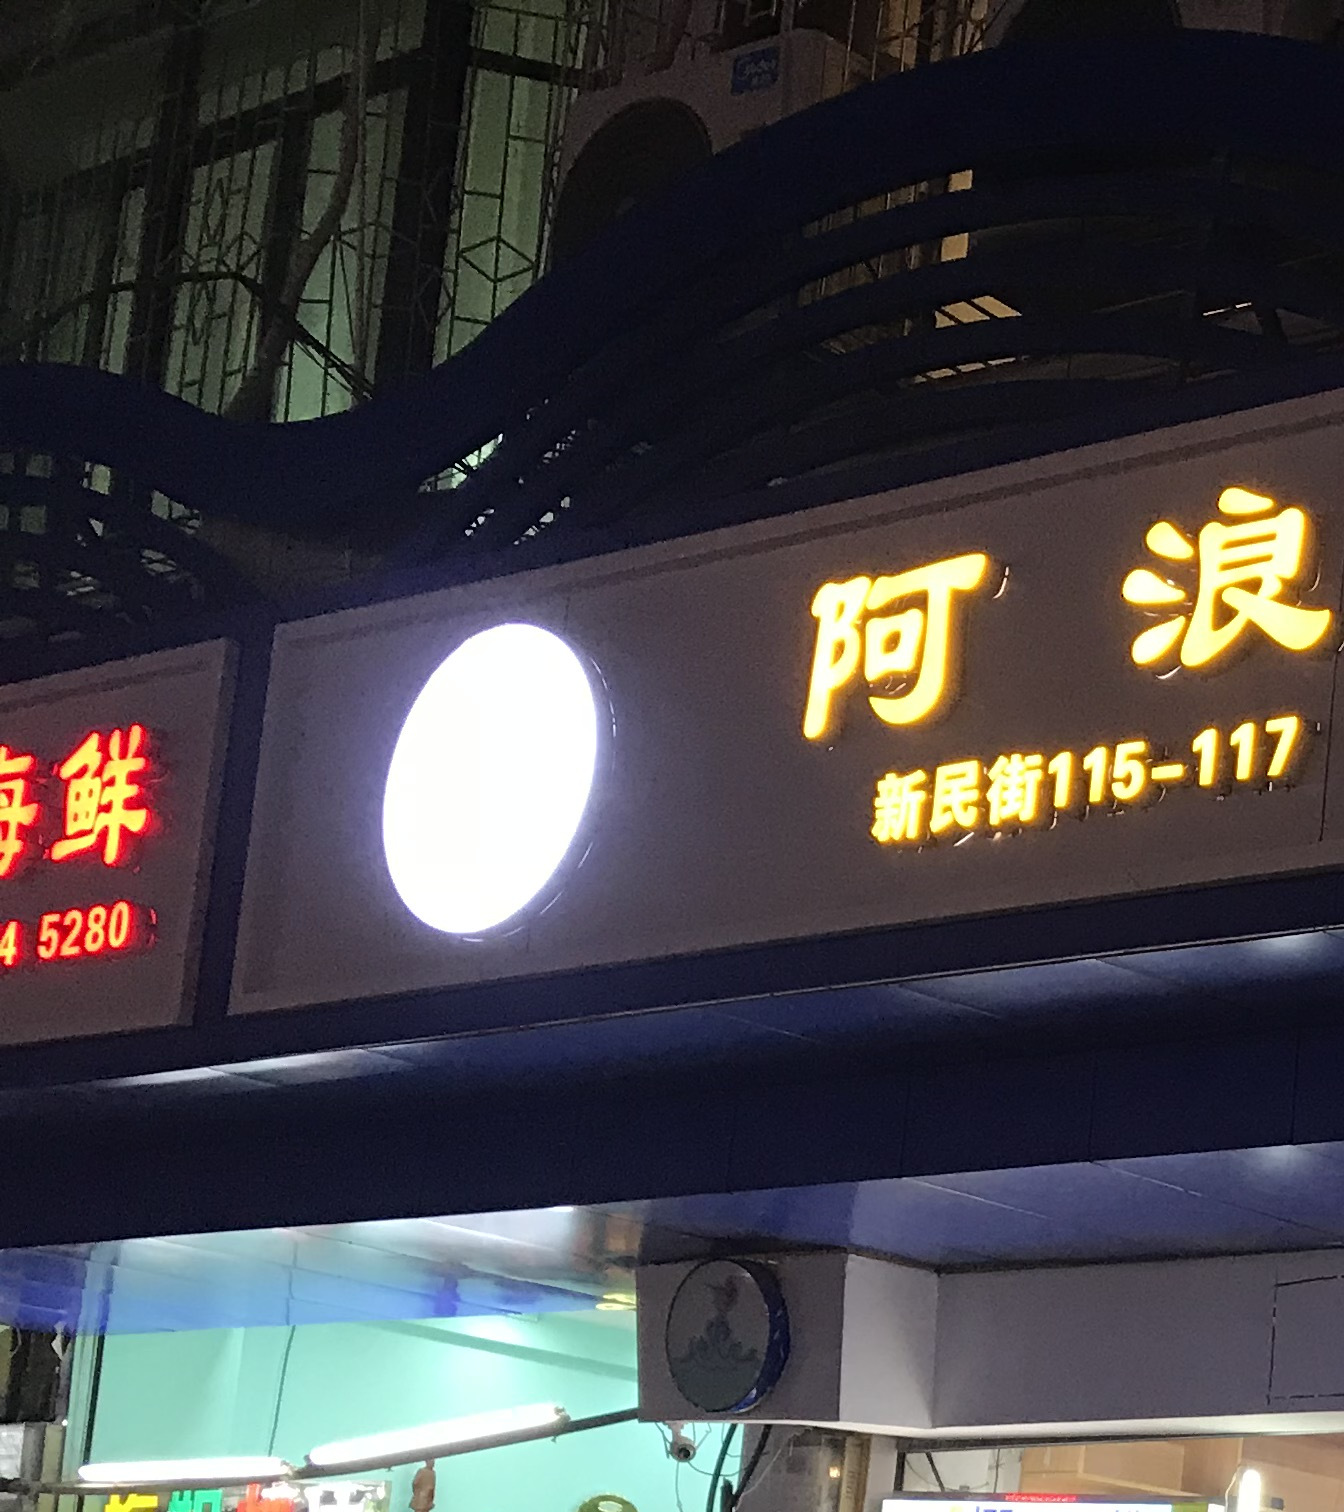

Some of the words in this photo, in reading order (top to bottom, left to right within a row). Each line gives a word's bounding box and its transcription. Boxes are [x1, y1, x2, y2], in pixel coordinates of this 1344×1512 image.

[870, 715, 1299, 843] 新民街115-117
[36, 900, 131, 961] 5280
